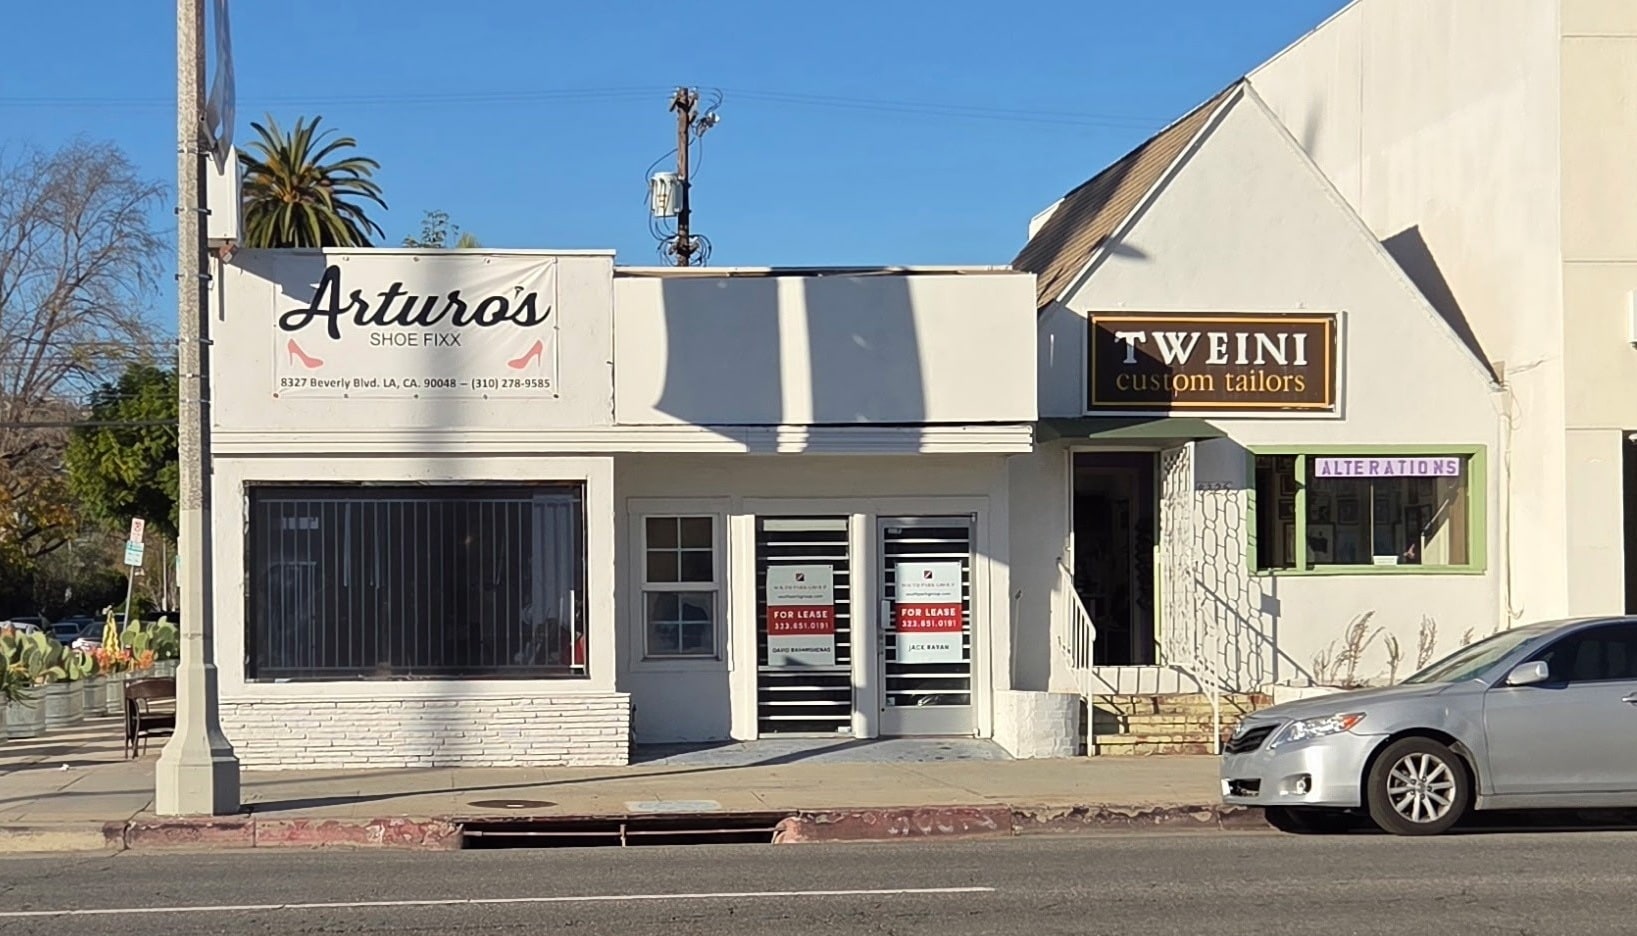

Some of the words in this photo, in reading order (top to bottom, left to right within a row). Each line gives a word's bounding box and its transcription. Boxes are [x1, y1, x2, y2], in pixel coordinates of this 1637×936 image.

[279, 265, 551, 339] Arturo's
[370, 332, 418, 346] SHOE
[424, 332, 461, 346] FIXX
[1114, 330, 1308, 366] TWEINI
[280, 378, 307, 388] 8327
[310, 378, 350, 390] Beverly
[354, 378, 380, 388] Blvd.
[383, 378, 400, 389] LA,
[403, 378, 420, 388] CA.
[424, 378, 457, 388] 90048
[471, 378, 499, 390] (310)
[502, 378, 550, 388] 278-9585
[1116, 371, 1215, 392] custom
[1225, 369, 1306, 392] tailors
[1322, 460, 1457, 475] ALTERATIONS
[774, 611, 794, 619] FOR
[797, 610, 828, 618] LEASE
[901, 608, 921, 616] FOR
[925, 607, 956, 616] LEASE
